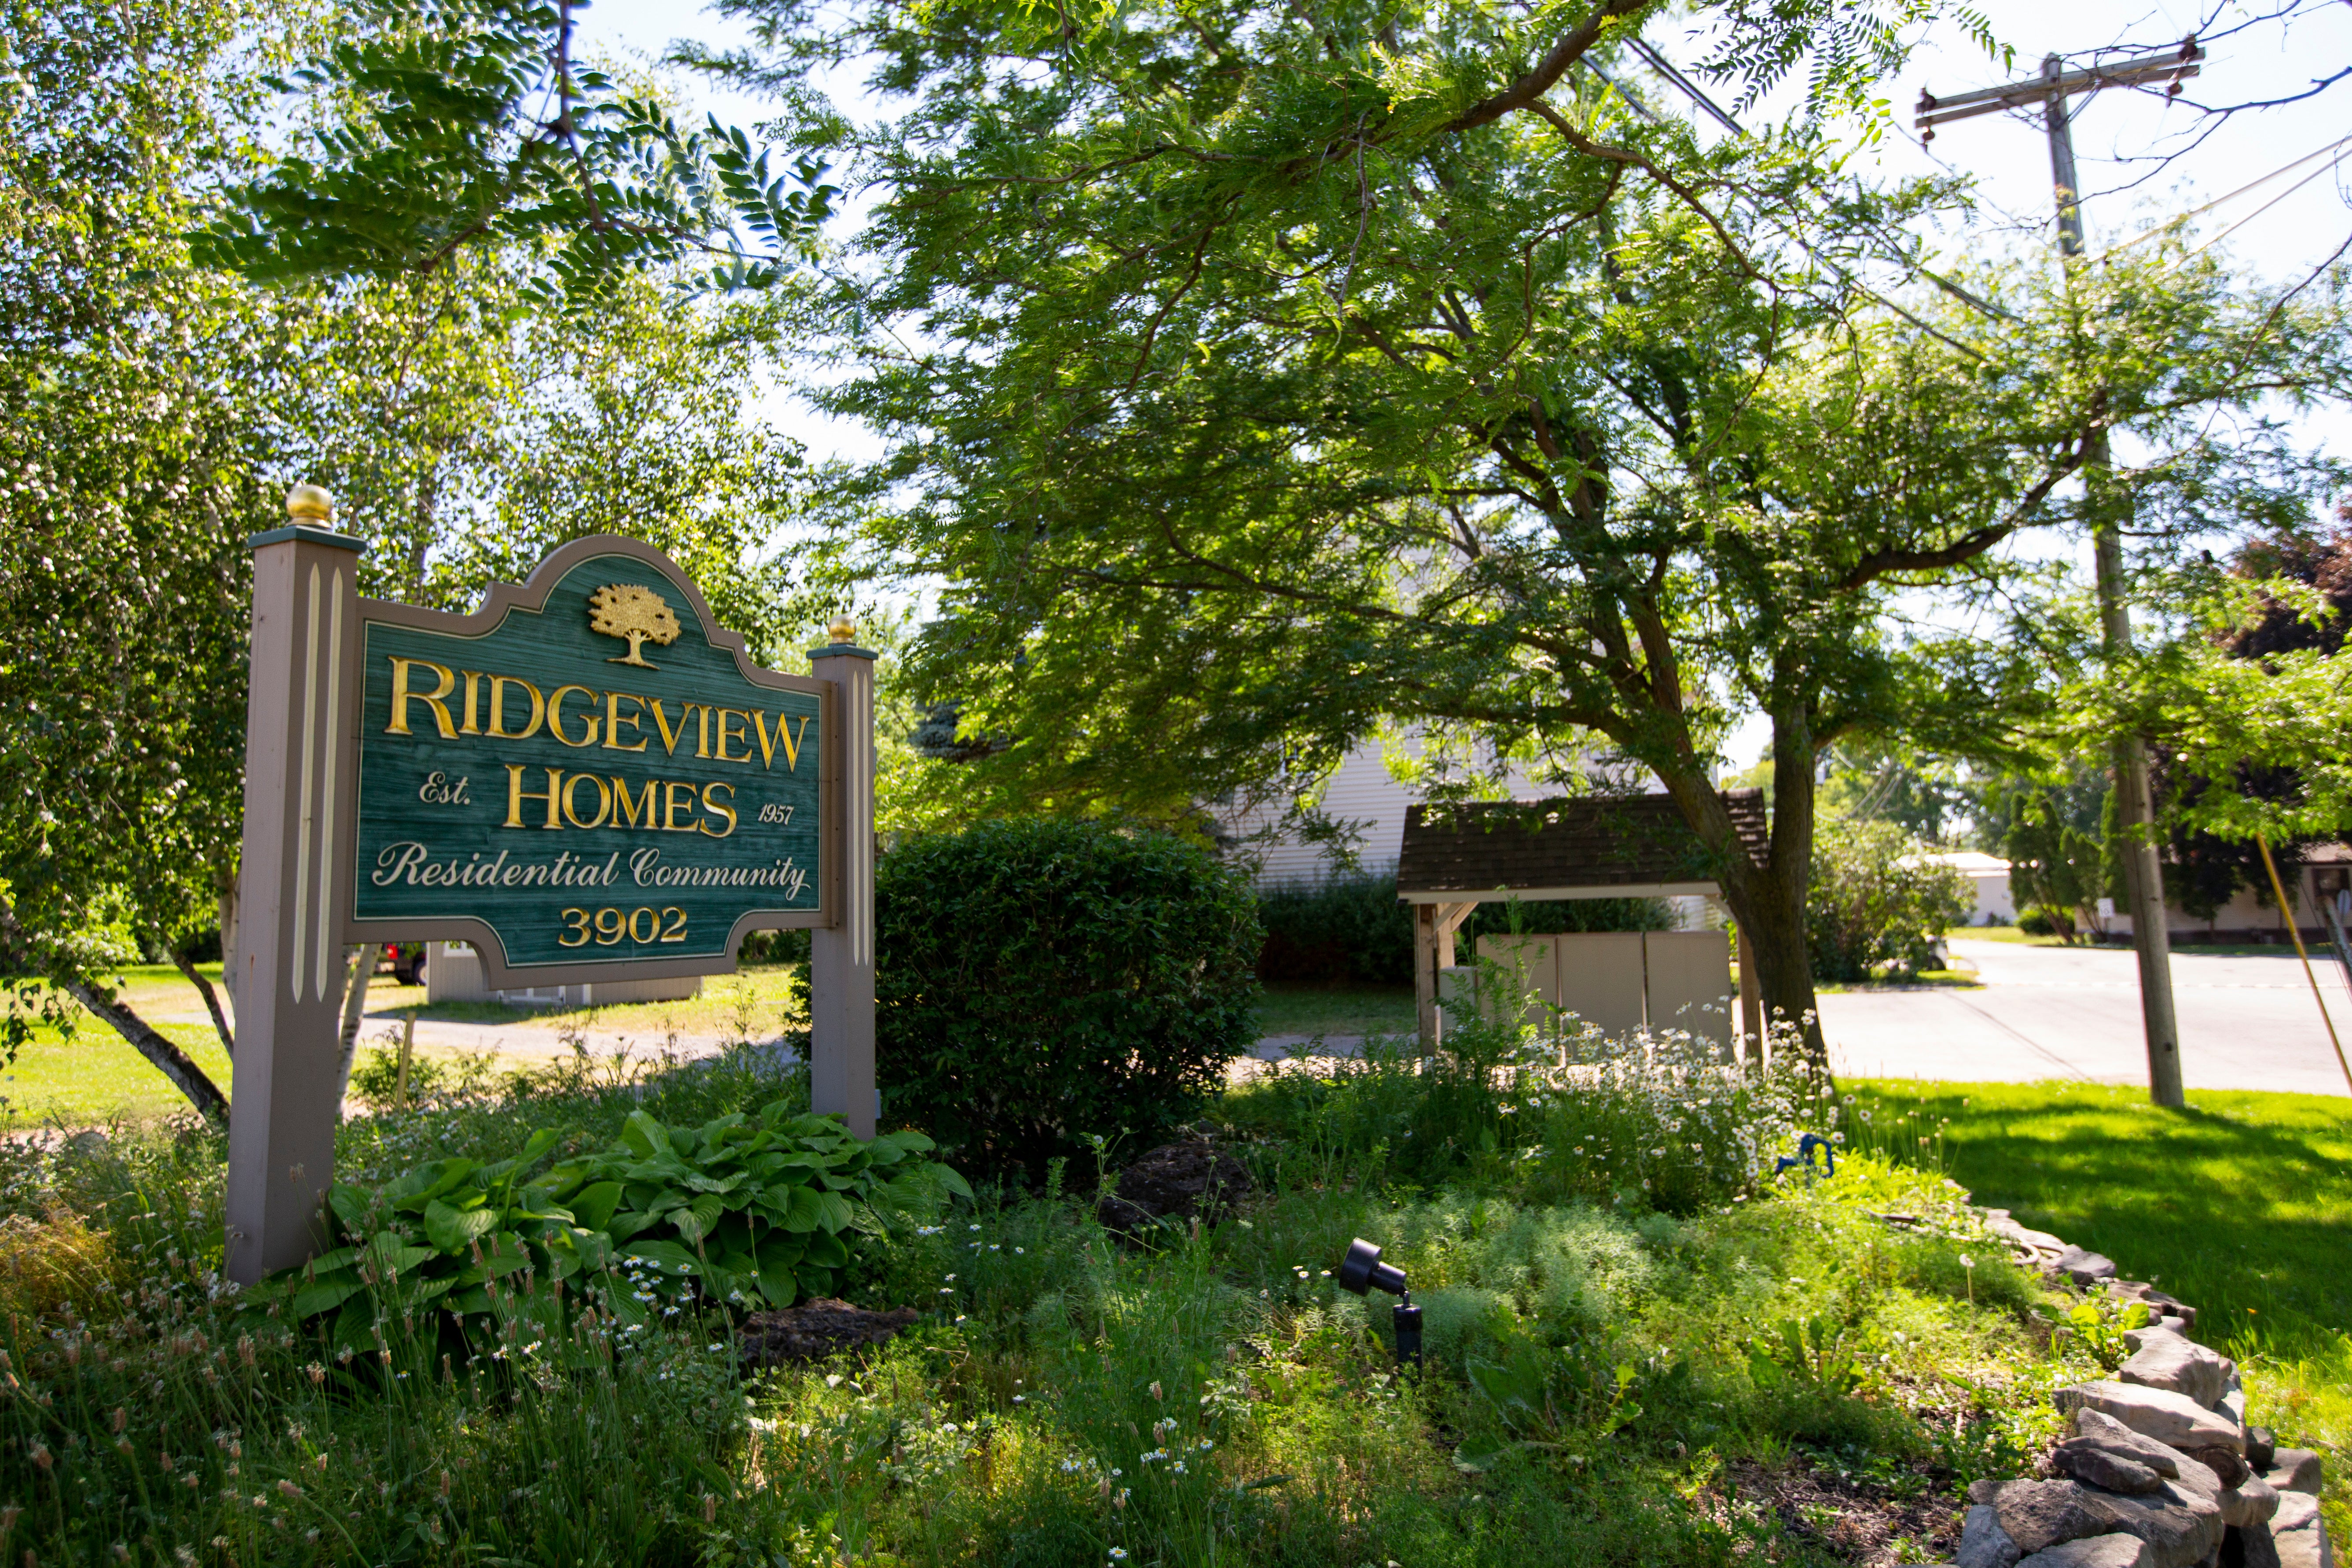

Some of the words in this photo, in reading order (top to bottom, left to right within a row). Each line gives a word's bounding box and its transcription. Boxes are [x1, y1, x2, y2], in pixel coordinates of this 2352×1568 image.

[384, 655, 810, 772] RIDGEVIEW
[419, 772, 470, 804] Est.
[503, 764, 737, 837] HOMES
[758, 803, 794, 825] 1957
[373, 842, 619, 887] Residential
[630, 848, 811, 900] Community
[559, 907, 688, 947] 3902
